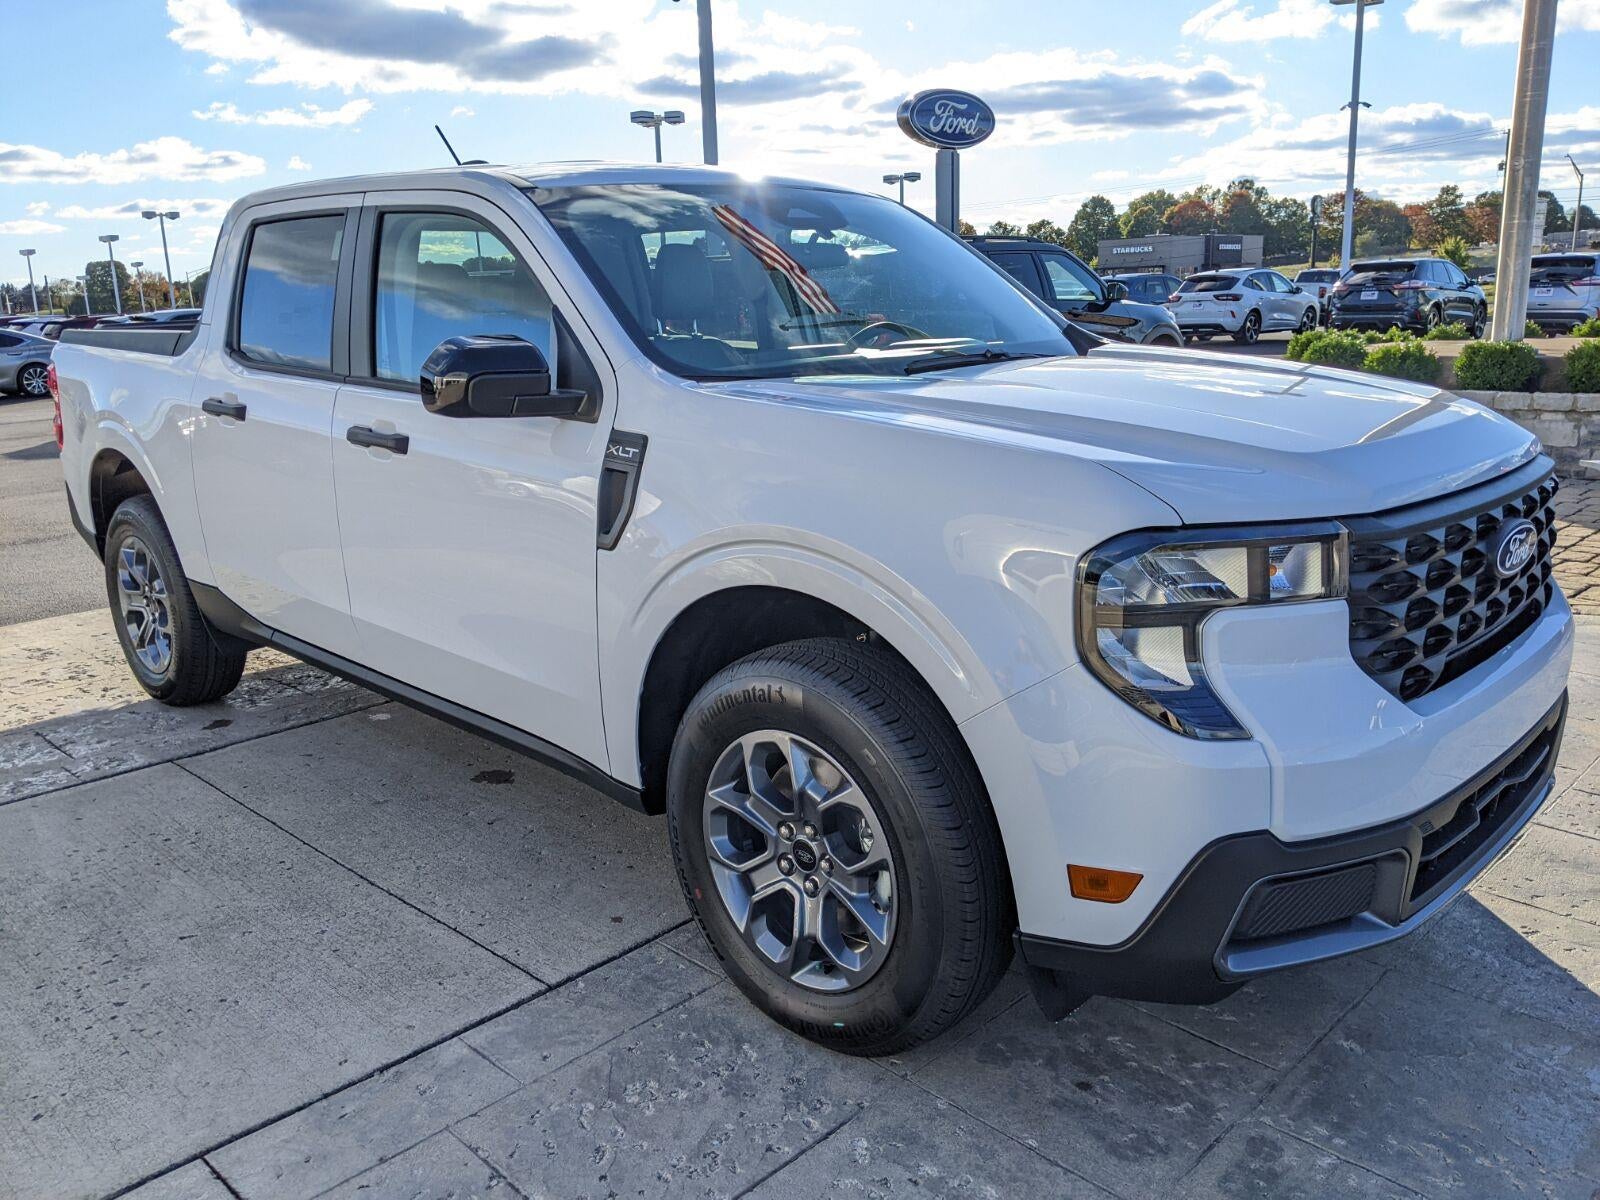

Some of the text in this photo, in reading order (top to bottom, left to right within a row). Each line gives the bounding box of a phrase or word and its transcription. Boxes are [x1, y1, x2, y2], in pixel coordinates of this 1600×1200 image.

[929, 100, 980, 135] Ford
[1112, 245, 1153, 254] STARBUCKS
[606, 444, 639, 458] XLT
[1505, 531, 1532, 569] Ford
